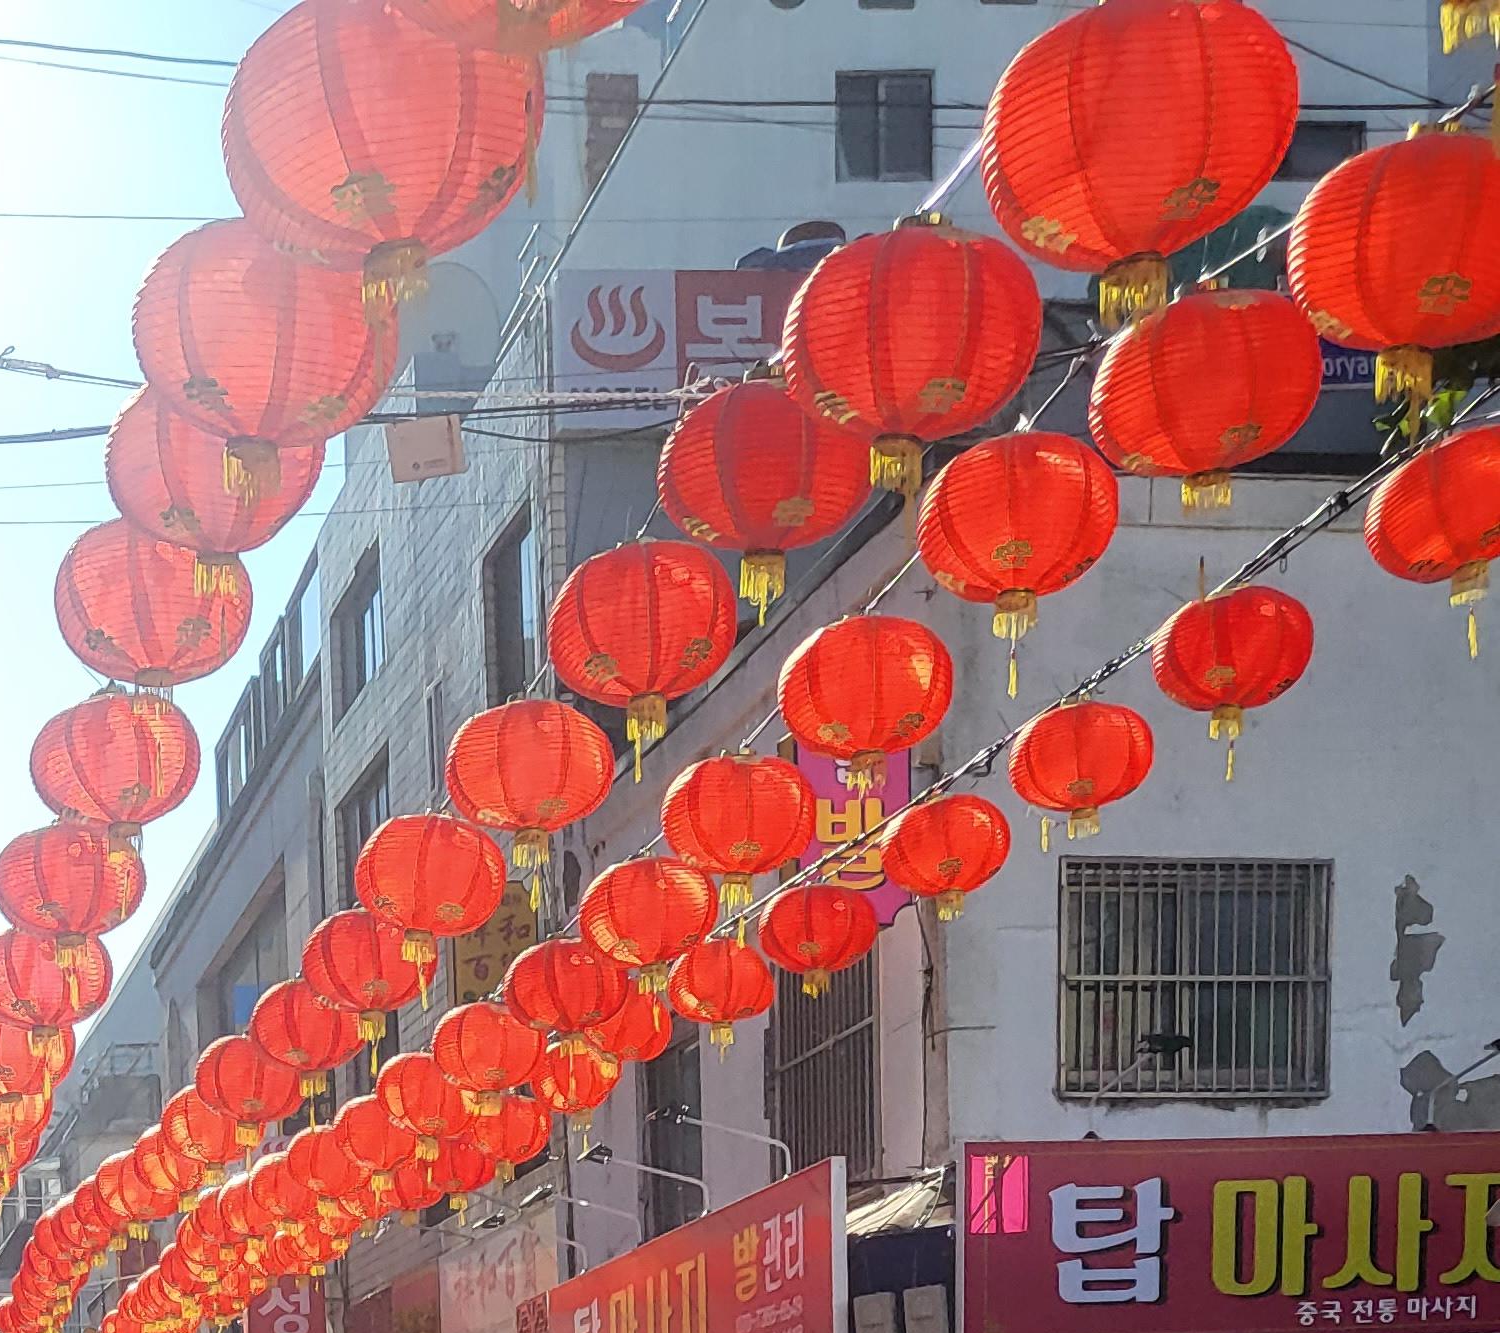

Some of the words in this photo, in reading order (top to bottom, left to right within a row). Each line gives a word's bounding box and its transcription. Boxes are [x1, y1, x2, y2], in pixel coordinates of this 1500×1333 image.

[1048, 1176, 1176, 1304] 탑
[1295, 1301, 1342, 1326] 중국
[1351, 1298, 1399, 1324] 전통
[1407, 1295, 1477, 1321] 마사지
